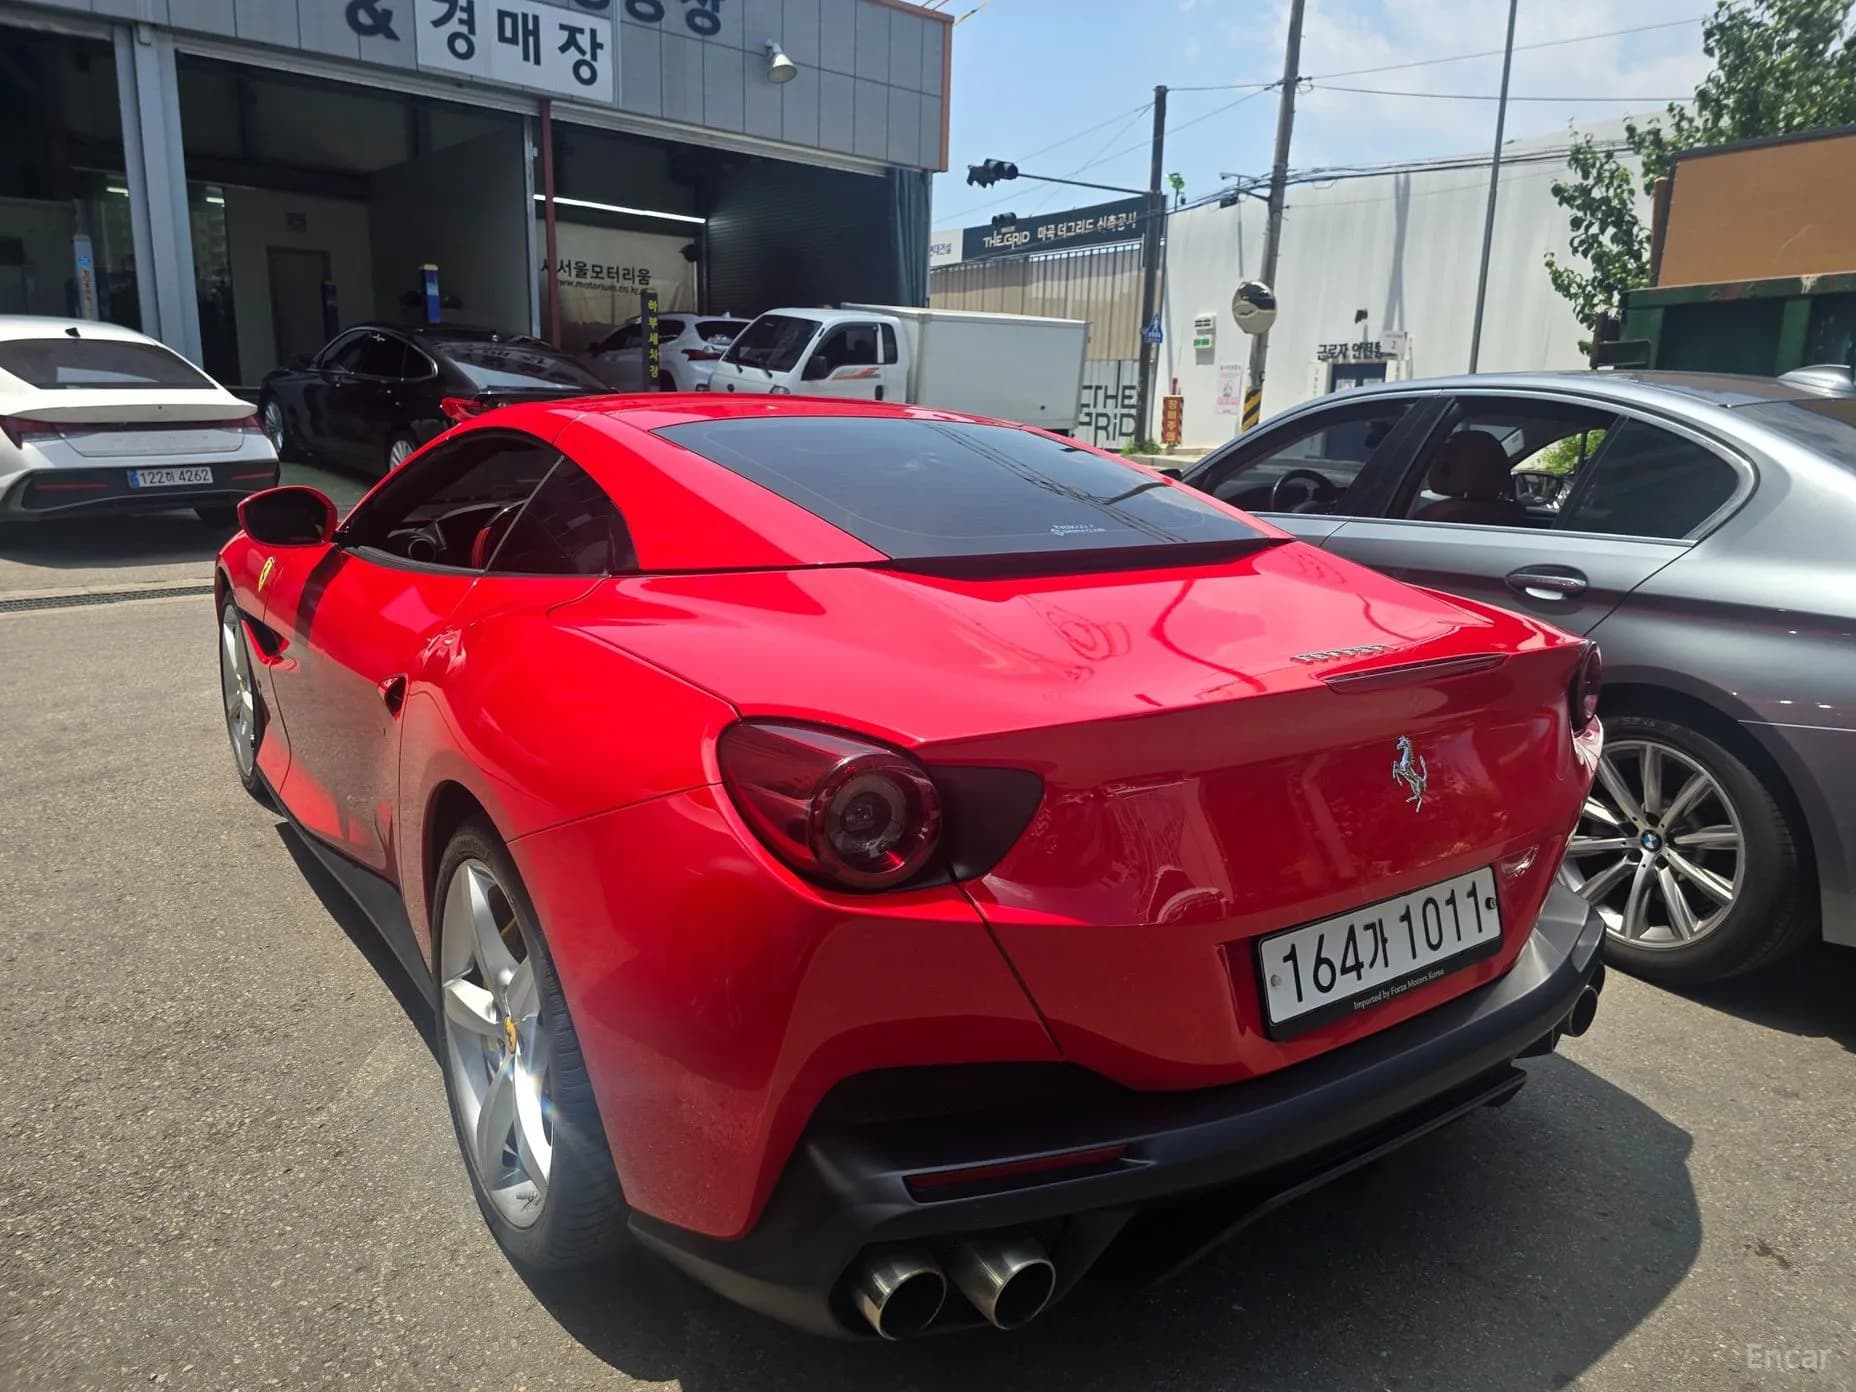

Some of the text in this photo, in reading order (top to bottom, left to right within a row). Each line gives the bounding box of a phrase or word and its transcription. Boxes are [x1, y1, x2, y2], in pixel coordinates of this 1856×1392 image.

[430, 0, 604, 86] 경매장
[178, 468, 209, 482] 4262
[1282, 880, 1483, 1003] 164가 1011
[1353, 991, 1382, 1010] Imported
[1407, 975, 1428, 988] Motors
[1428, 969, 1444, 980] Korea
